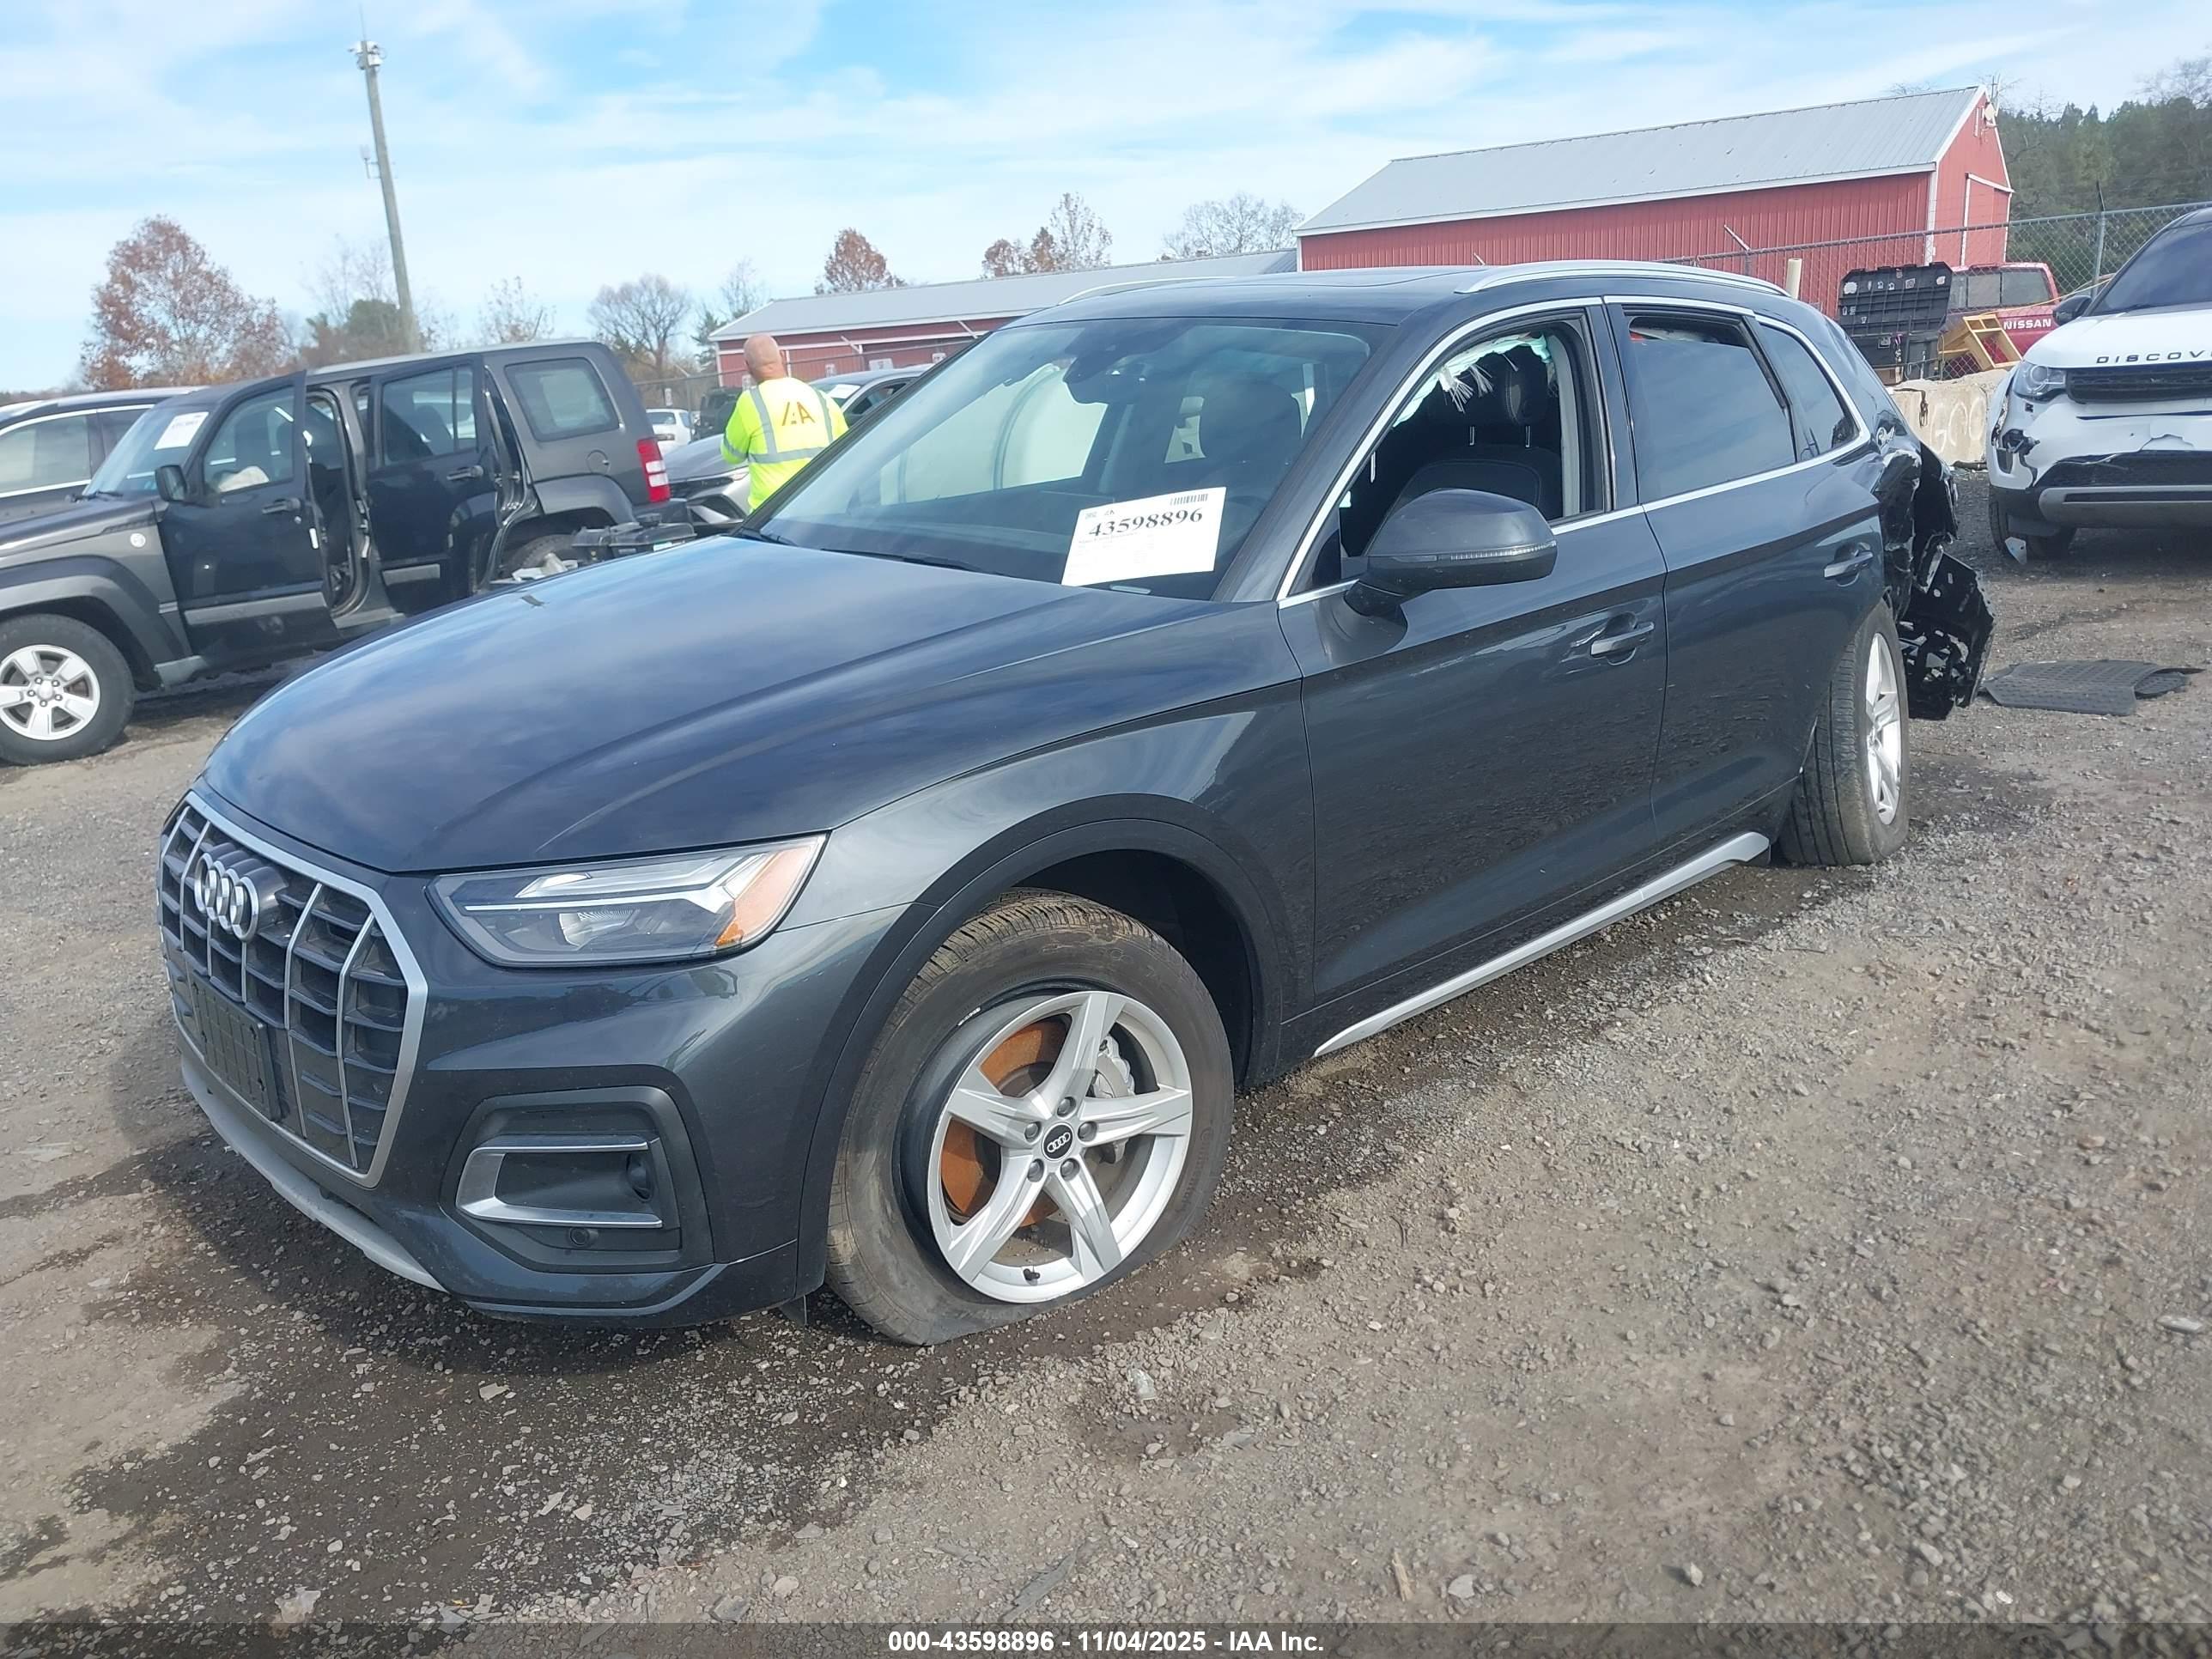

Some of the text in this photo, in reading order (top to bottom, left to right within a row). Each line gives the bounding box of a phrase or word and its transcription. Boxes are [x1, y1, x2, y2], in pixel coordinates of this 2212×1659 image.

[2003, 319, 2051, 331] NISSAN
[2096, 349, 2212, 364] DISCOV
[1089, 507, 1204, 537] 43598896
